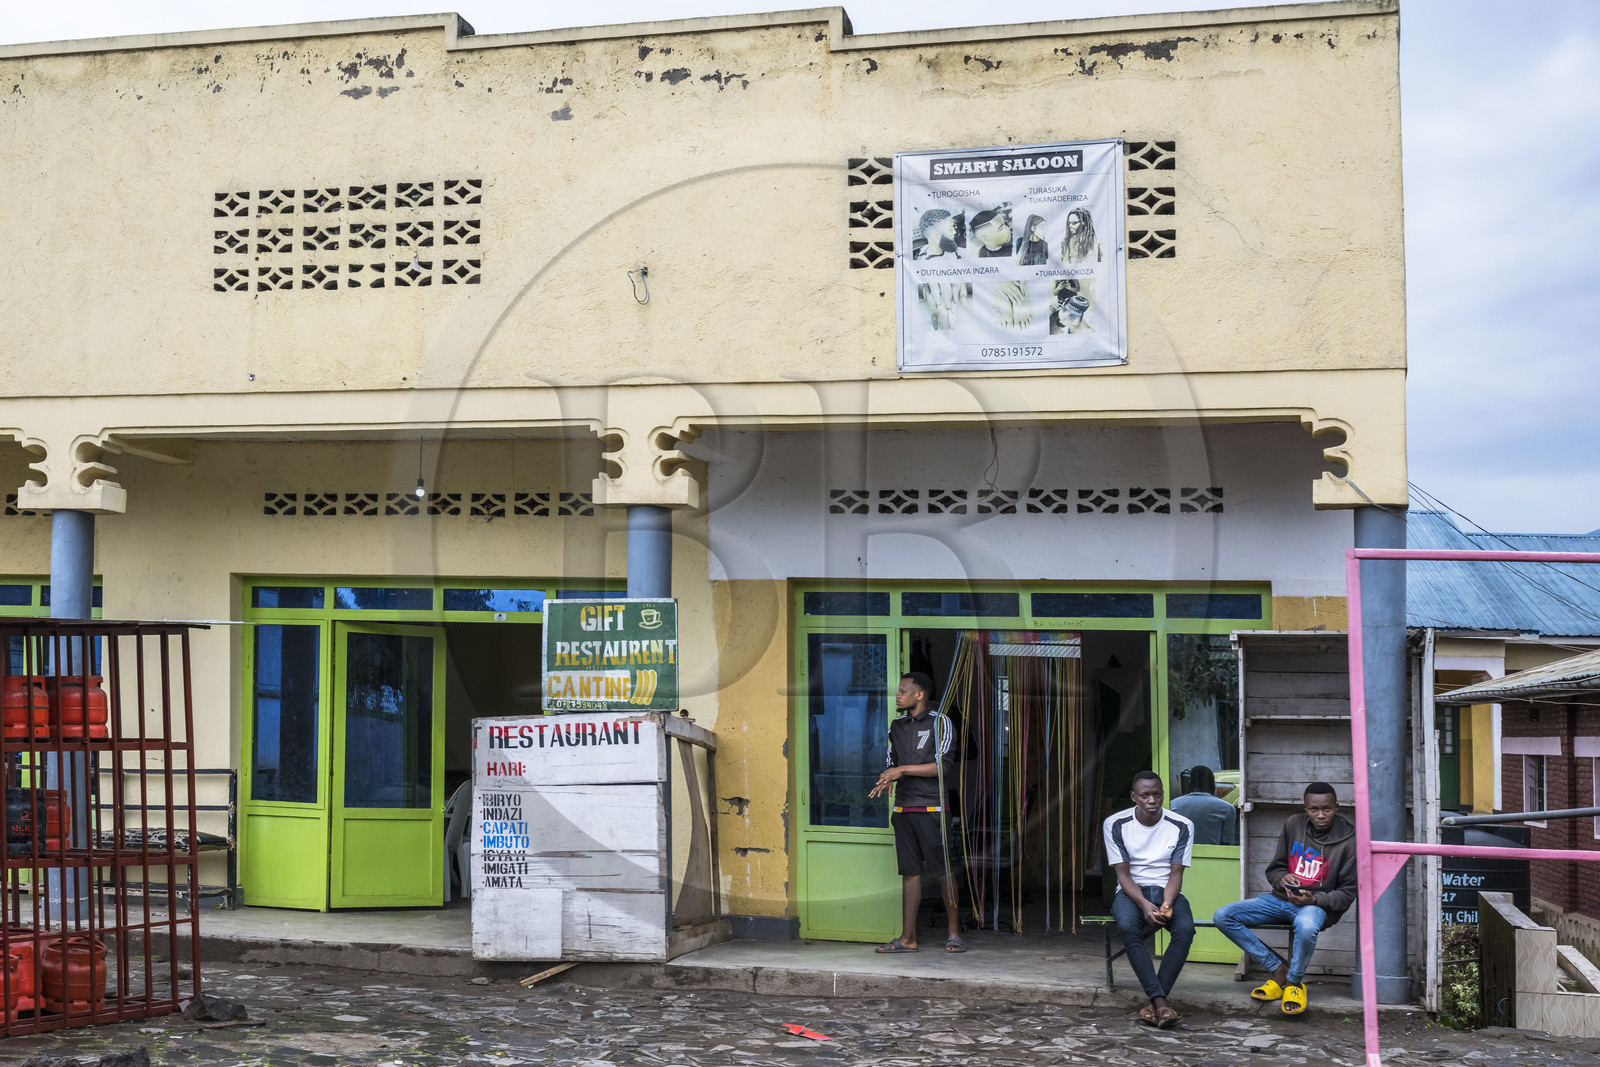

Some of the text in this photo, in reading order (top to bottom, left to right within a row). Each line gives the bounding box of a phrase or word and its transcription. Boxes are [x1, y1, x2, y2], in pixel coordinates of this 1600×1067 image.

[933, 155, 1079, 175] SMART SALOON
[931, 189, 981, 199] TUROGOSHA
[1028, 185, 1068, 195] TURASUKA
[1028, 194, 1089, 204] TUKANADEFIRIZA
[920, 266, 1000, 277] DUTUNGANYA INZARA
[1039, 268, 1095, 277] TURANASOKOZA
[981, 347, 1043, 358] 0785191572
[580, 604, 626, 632] GIFT
[555, 639, 677, 666] RESTAURENT
[547, 675, 631, 700] CANTINE
[489, 721, 642, 749] RESTAURANT
[917, 729, 930, 749] 7
[482, 793, 521, 806] IBIRYO
[483, 807, 522, 820] INDAZI
[483, 821, 528, 834] CAPATI
[483, 835, 529, 848] IMBUTO
[484, 862, 528, 874] IMIGATI
[484, 876, 523, 888] AMATA
[1442, 873, 1485, 886] Water
